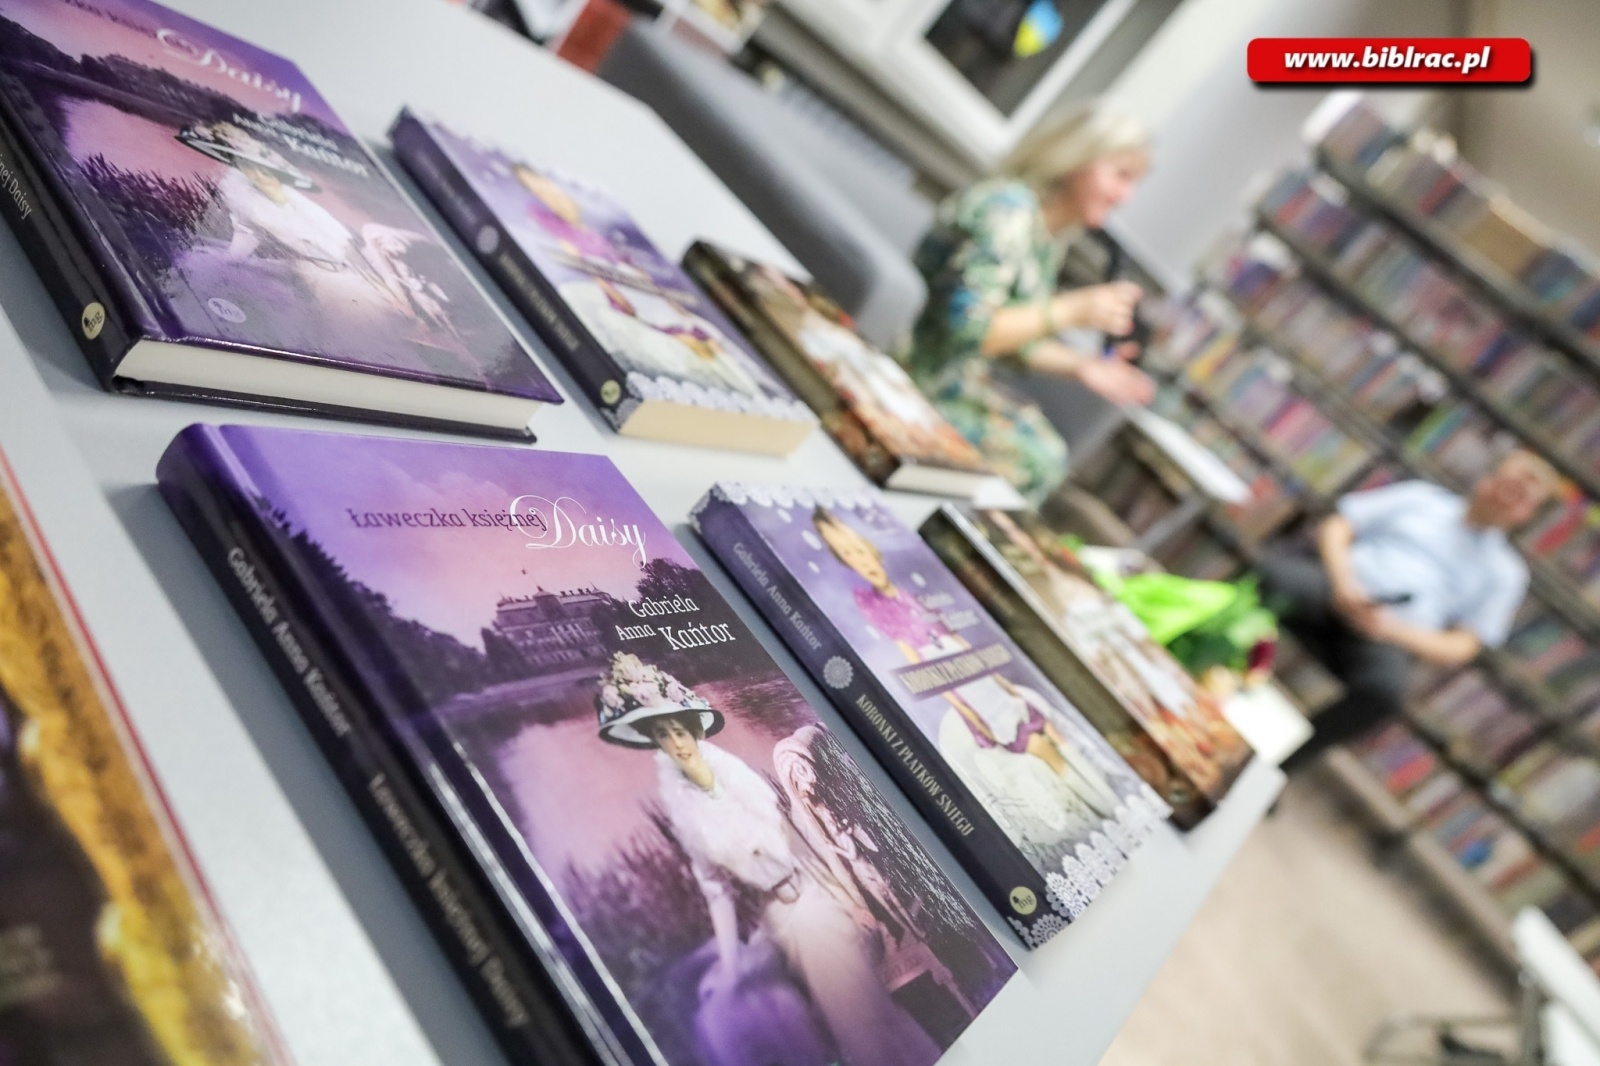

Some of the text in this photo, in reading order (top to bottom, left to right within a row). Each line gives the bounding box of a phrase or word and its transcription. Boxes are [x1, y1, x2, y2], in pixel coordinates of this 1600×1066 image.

[9, 178, 32, 220] Daisy
[346, 495, 647, 569] Ławeczka księżnej Daisy
[228, 547, 278, 625] Gabriela
[272, 620, 309, 674] Anna
[628, 594, 700, 618] Gabriela
[733, 542, 822, 650] Gabriela Anna Kańtor
[614, 621, 736, 650] Anna Kańtor
[856, 694, 898, 743] KORONKI
[891, 738, 904, 750] Z
[898, 745, 943, 797] PŁATKÓW
